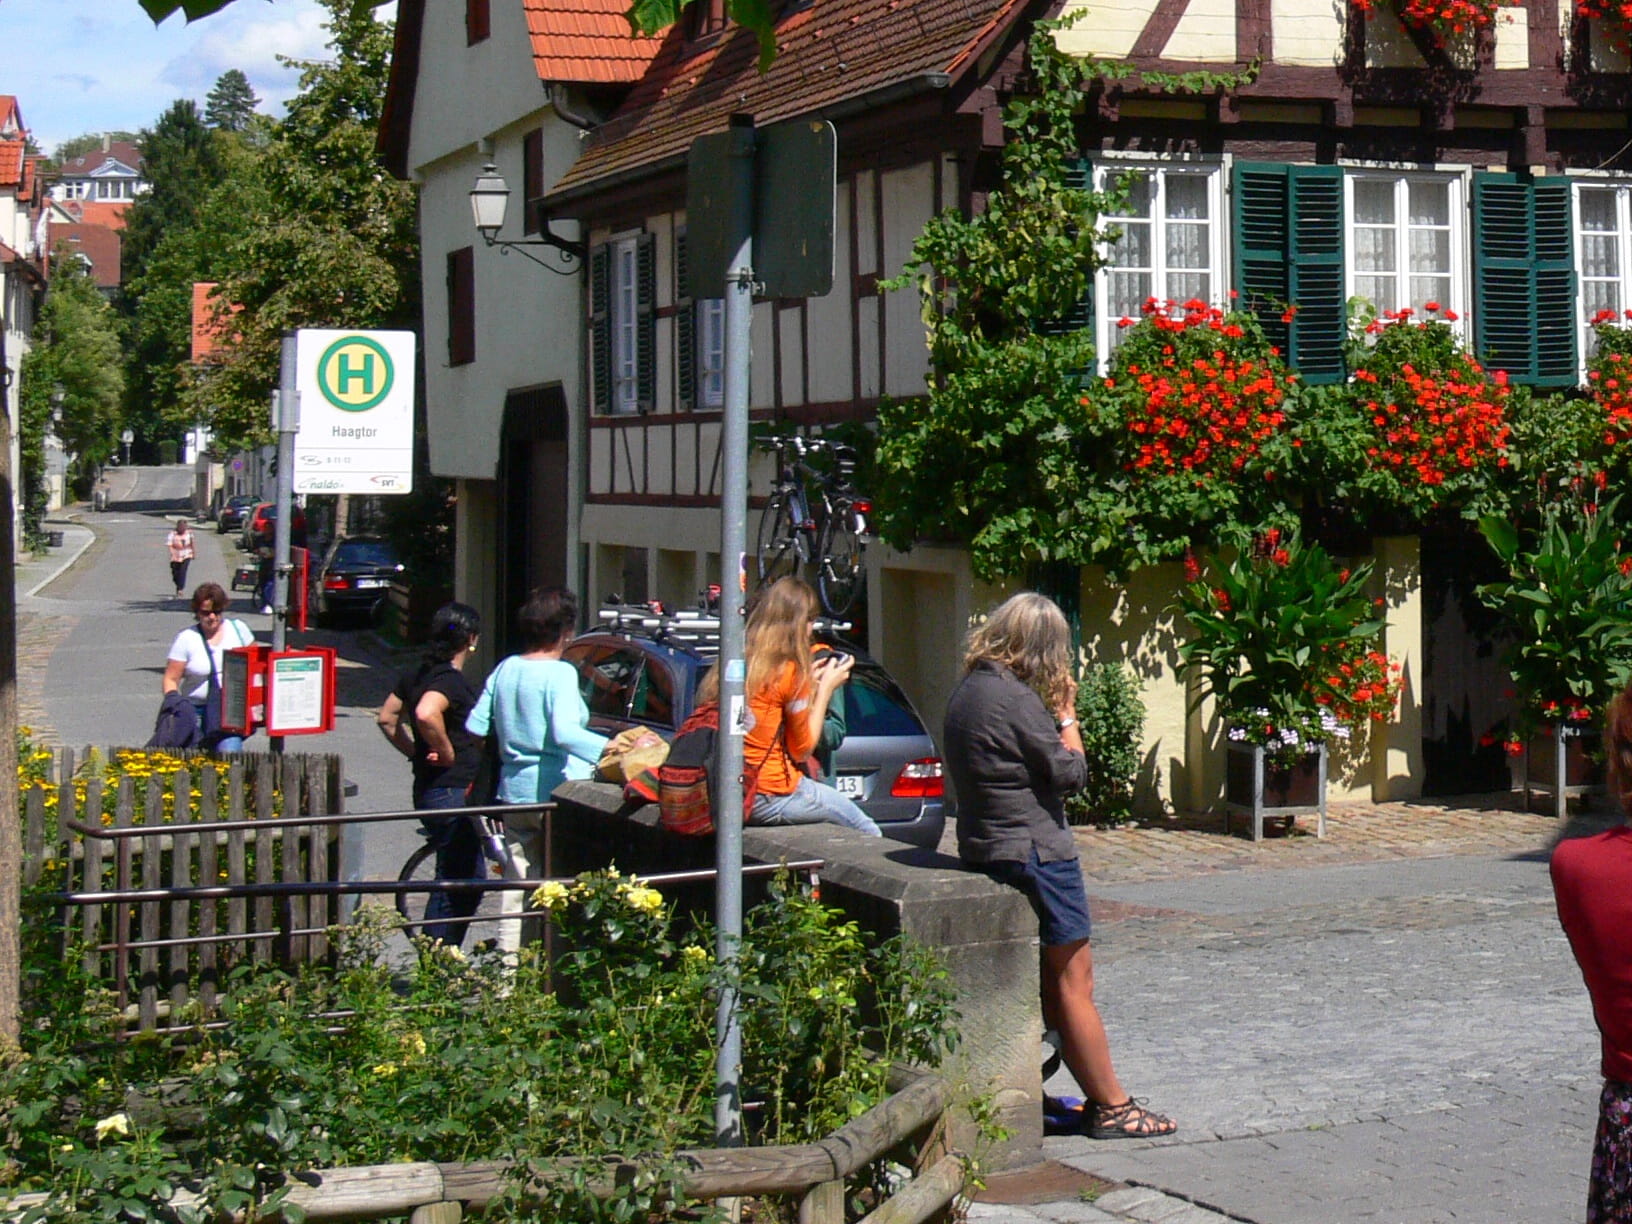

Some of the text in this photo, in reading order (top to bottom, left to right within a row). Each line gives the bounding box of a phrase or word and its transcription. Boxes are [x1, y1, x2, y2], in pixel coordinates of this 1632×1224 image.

[338, 353, 375, 394] H
[332, 425, 378, 440] Haagtor
[838, 777, 857, 793] 13
